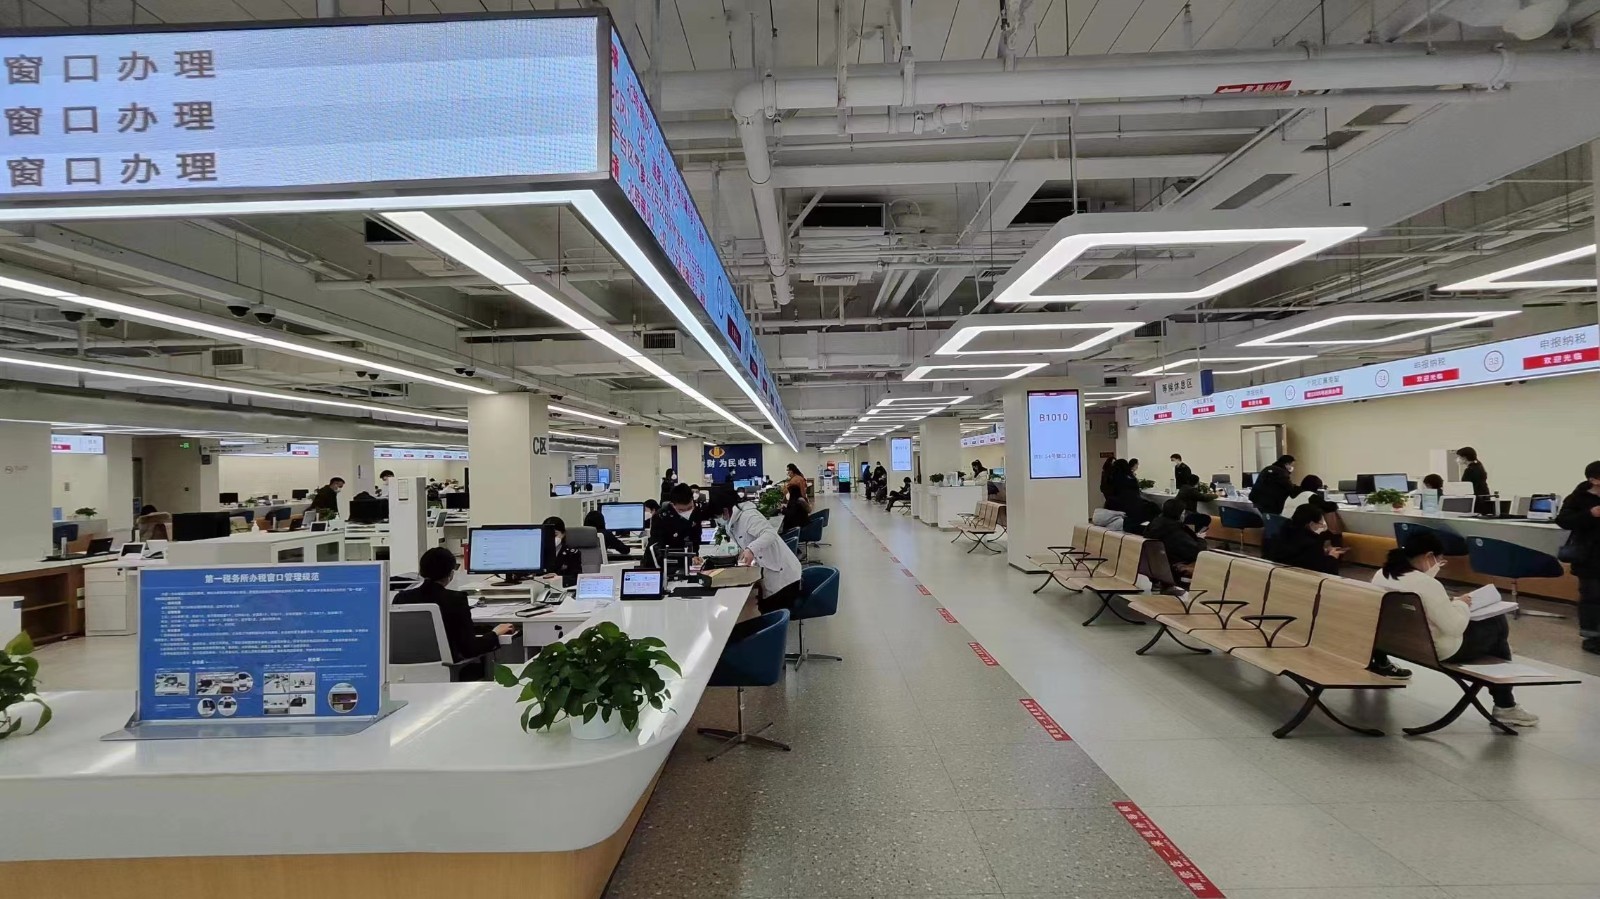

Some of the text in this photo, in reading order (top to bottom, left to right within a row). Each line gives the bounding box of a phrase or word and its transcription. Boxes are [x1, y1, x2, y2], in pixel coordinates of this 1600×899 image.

[4, 50, 215, 84] 窗口办理
[4, 101, 215, 136] 窗口办理
[6, 152, 218, 187] 窗口办理
[1540, 333, 1587, 349] 申报纳税
[1543, 352, 1583, 364] 欢迎光临
[1162, 378, 1193, 393] 等候休息区
[1040, 413, 1068, 421] B1010
[533, 437, 547, 455] C区
[204, 572, 320, 583] 第一税务所办税窗口管理规范
